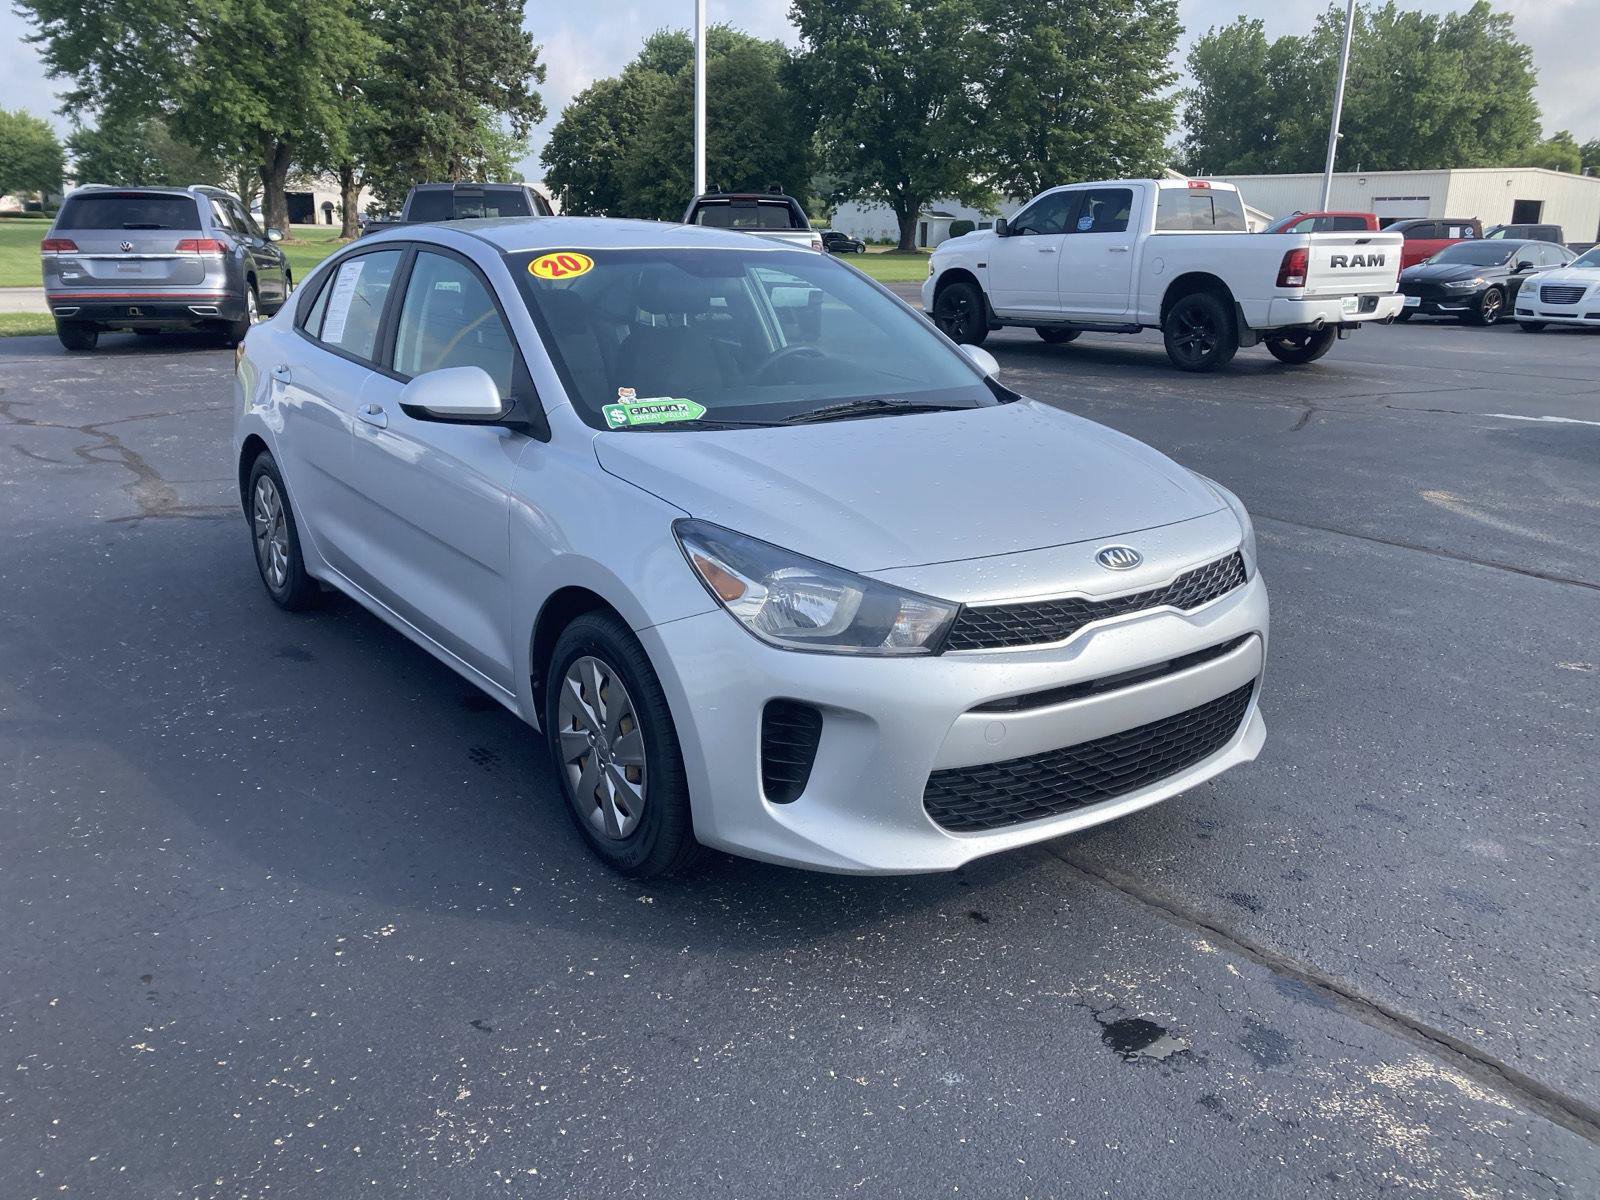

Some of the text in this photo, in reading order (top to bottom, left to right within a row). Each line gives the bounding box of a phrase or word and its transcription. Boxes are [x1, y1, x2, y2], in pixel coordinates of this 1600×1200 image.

[541, 255, 581, 277] 20
[1330, 254, 1386, 268] RAM
[629, 403, 690, 415] CARFAX
